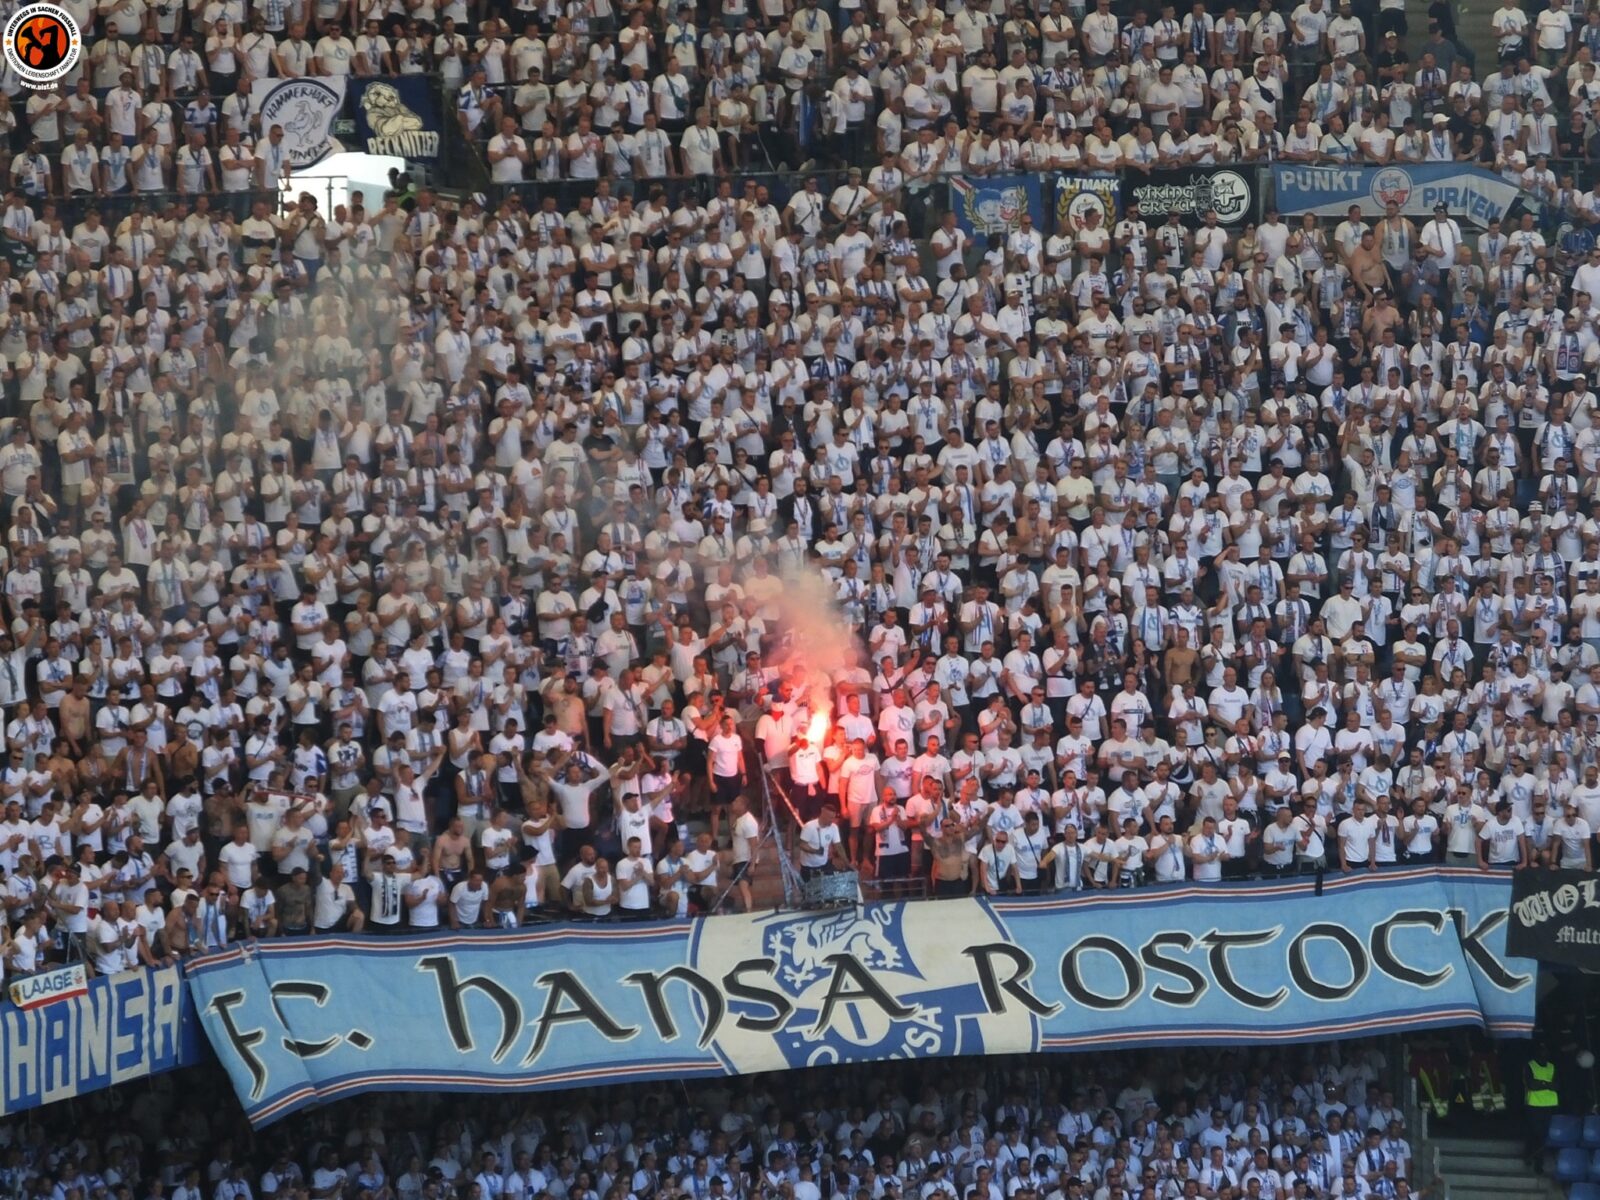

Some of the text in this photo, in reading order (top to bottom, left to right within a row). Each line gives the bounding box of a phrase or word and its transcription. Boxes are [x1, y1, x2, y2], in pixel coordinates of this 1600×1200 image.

[1056, 176, 1120, 191] ALTMARK
[1133, 185, 1194, 199] VIKING
[1280, 170, 1362, 191] PUNKT
[1422, 186, 1503, 221] PIRATEN
[1555, 925, 1600, 944] Mult
[962, 908, 1532, 1016] ROSTOCK
[22, 971, 73, 999] LAAGE
[5, 964, 180, 1101] HANSA
